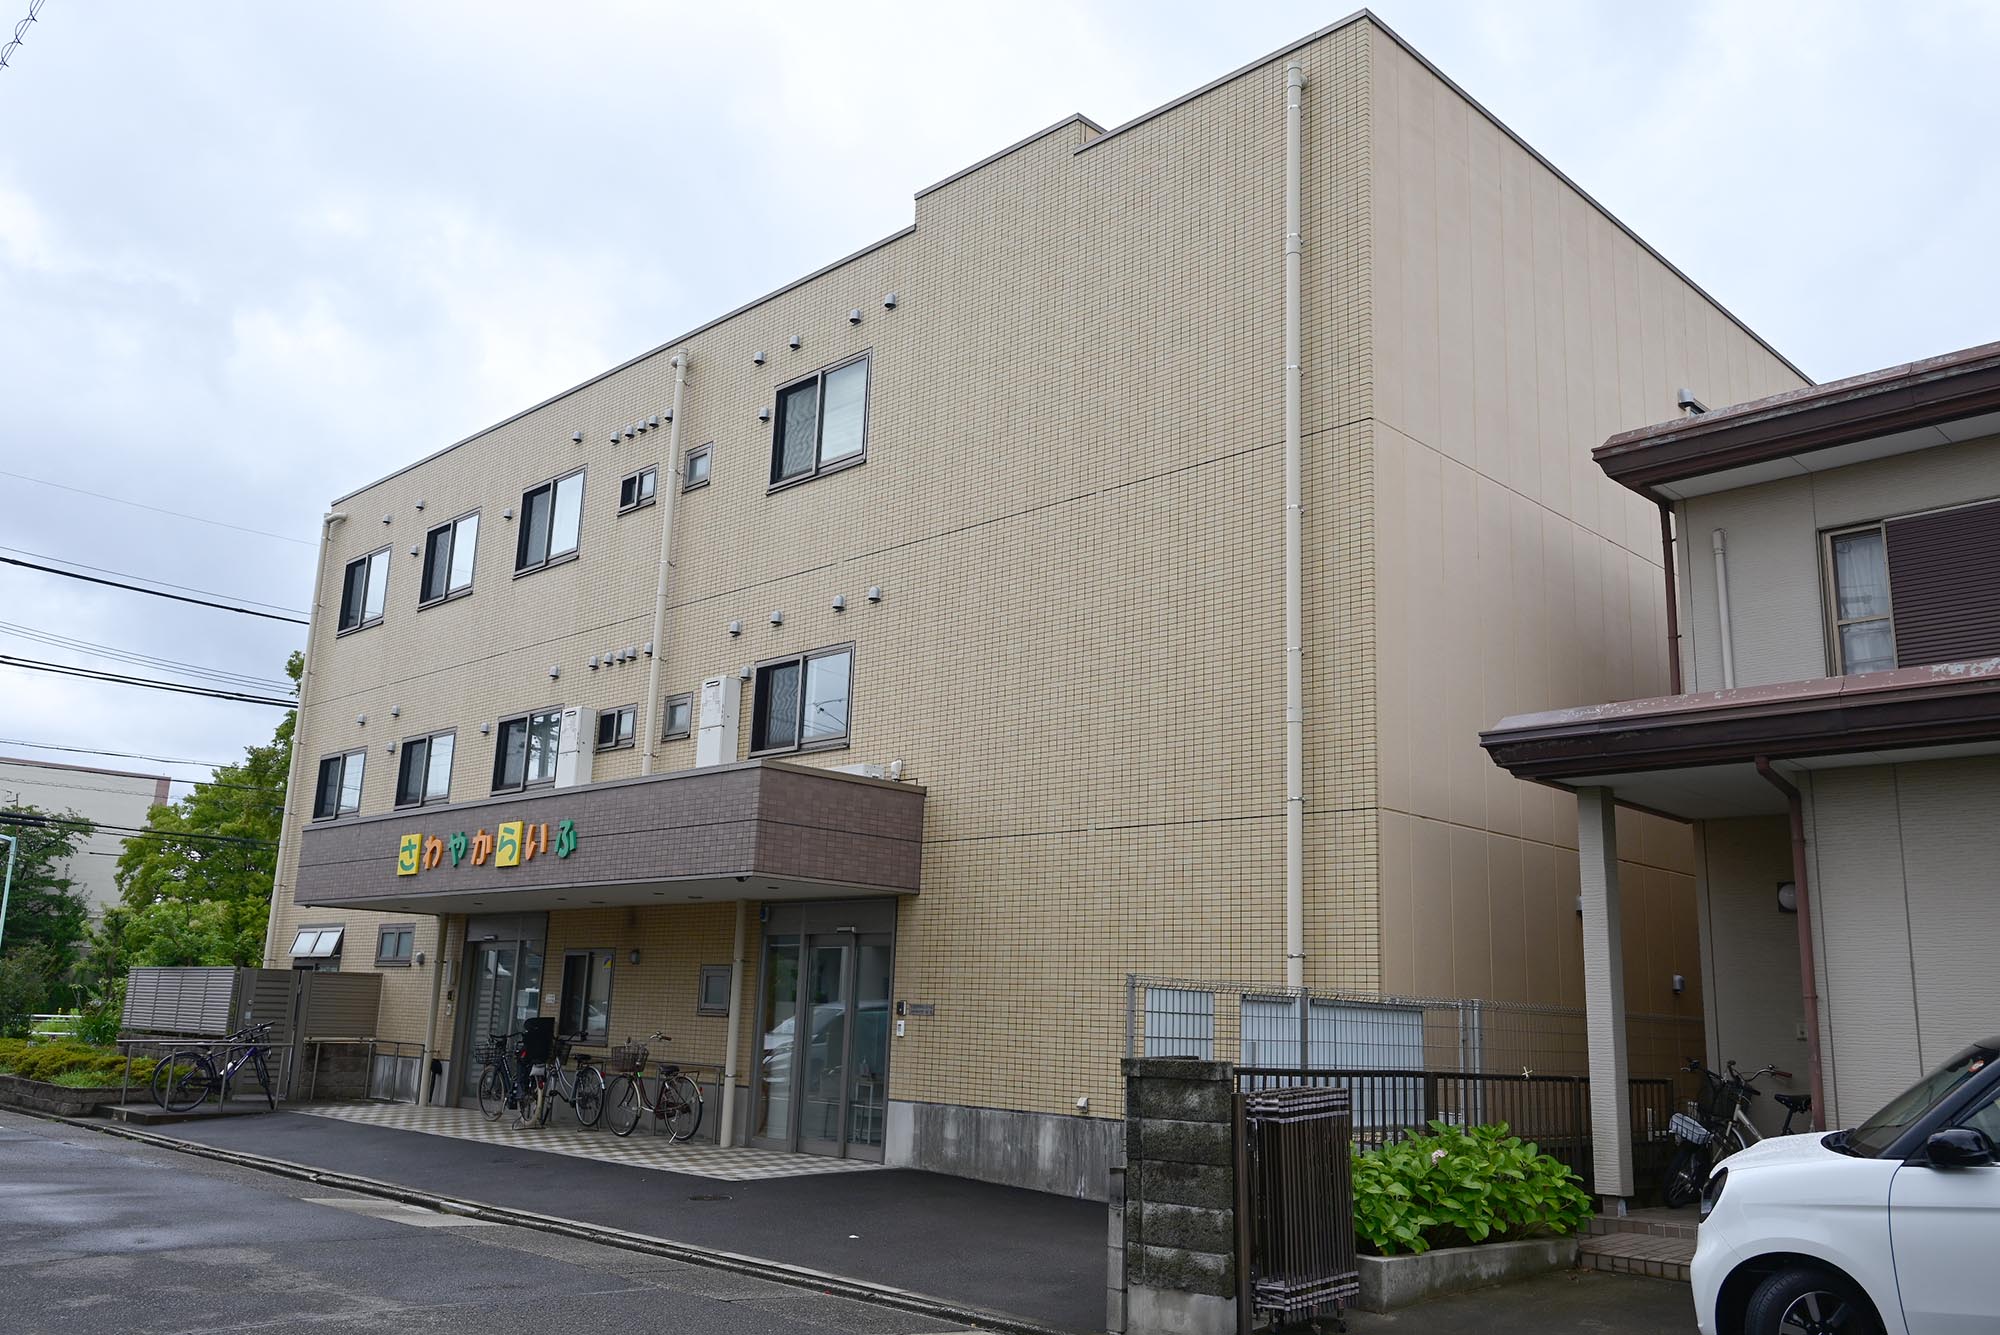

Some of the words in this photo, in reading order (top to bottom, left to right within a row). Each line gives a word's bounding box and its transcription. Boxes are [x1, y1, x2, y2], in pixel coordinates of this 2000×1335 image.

[398, 819, 577, 874] さわやからいふ
